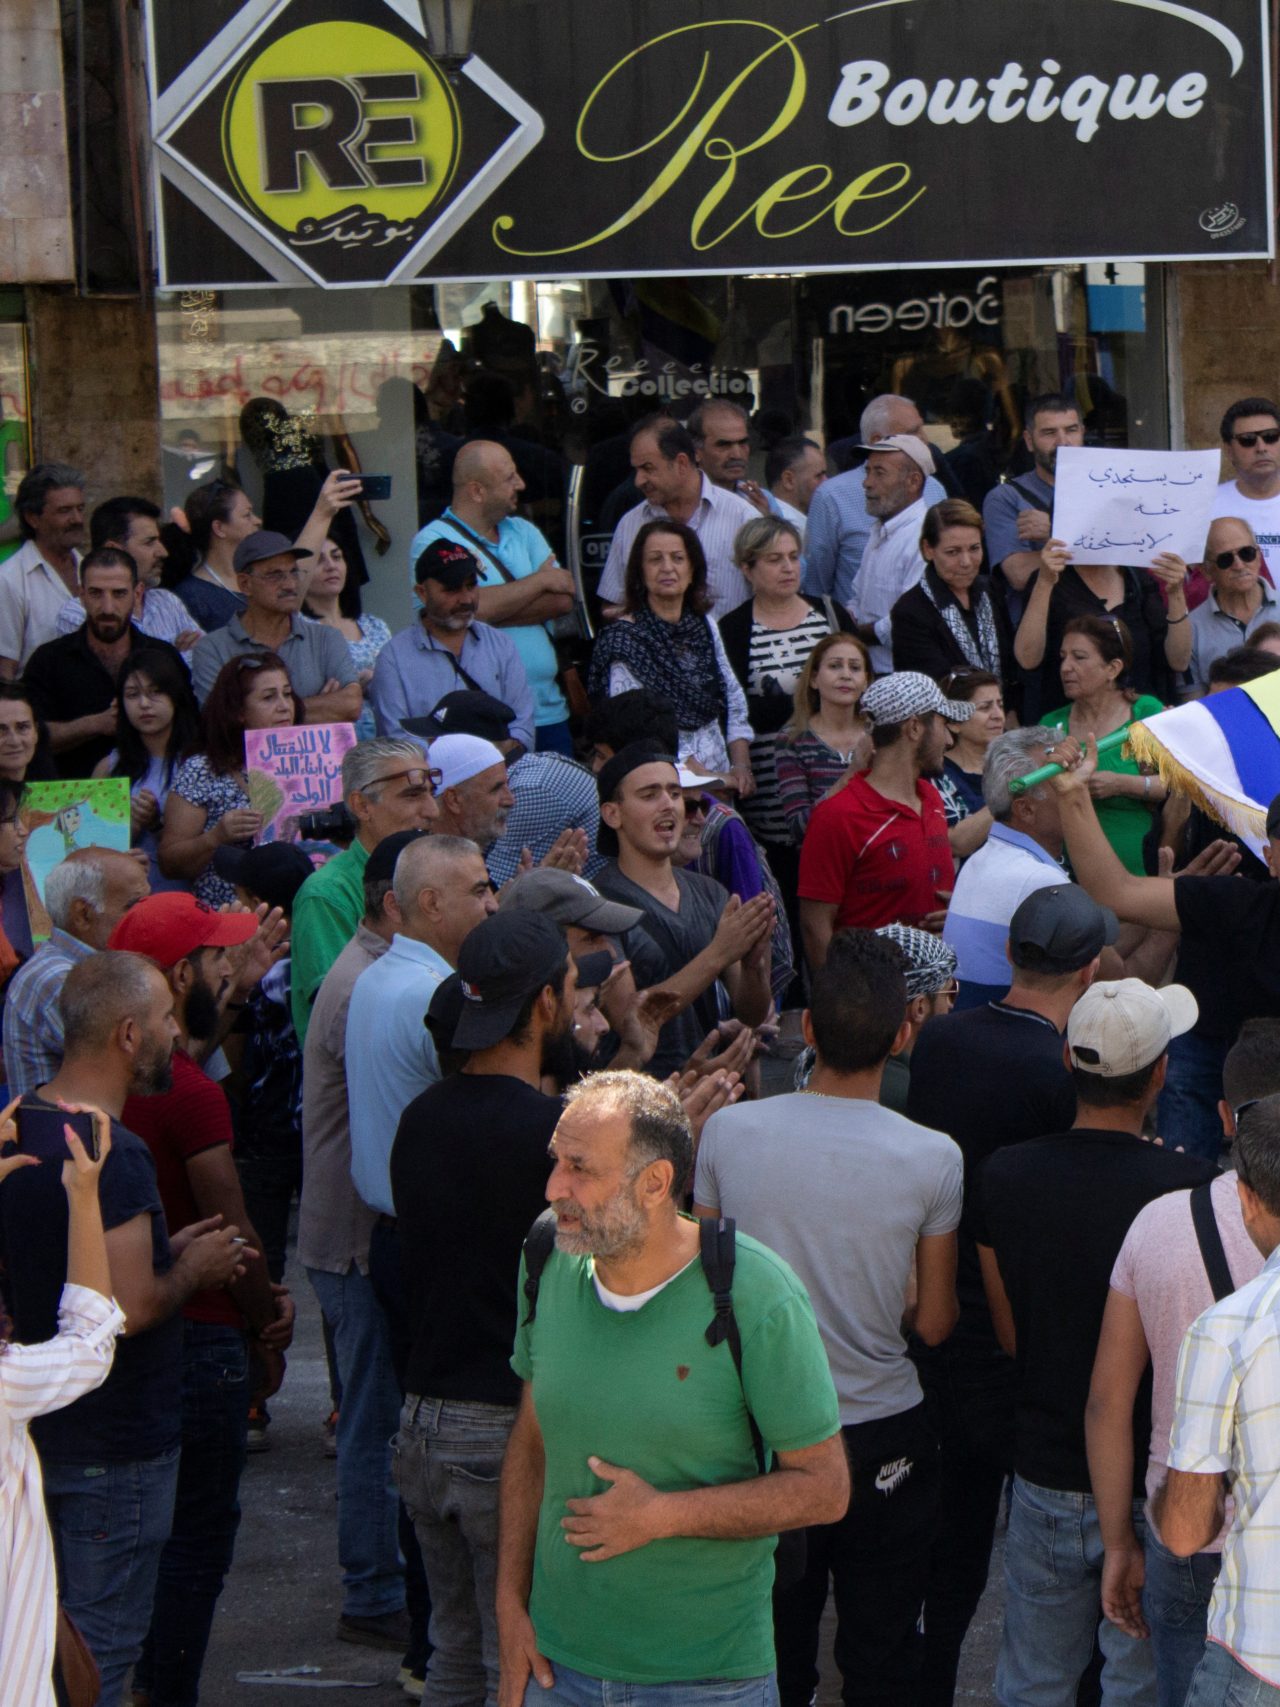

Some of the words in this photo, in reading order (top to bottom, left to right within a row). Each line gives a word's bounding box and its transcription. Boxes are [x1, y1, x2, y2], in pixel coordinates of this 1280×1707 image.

[827, 58, 1208, 143] Boutique
[256, 71, 427, 194] RE
[492, 20, 926, 256] Ree
[288, 211, 415, 249] بوتيك
[620, 374, 754, 397] Collection
[880, 1456, 908, 1477] NIKE
